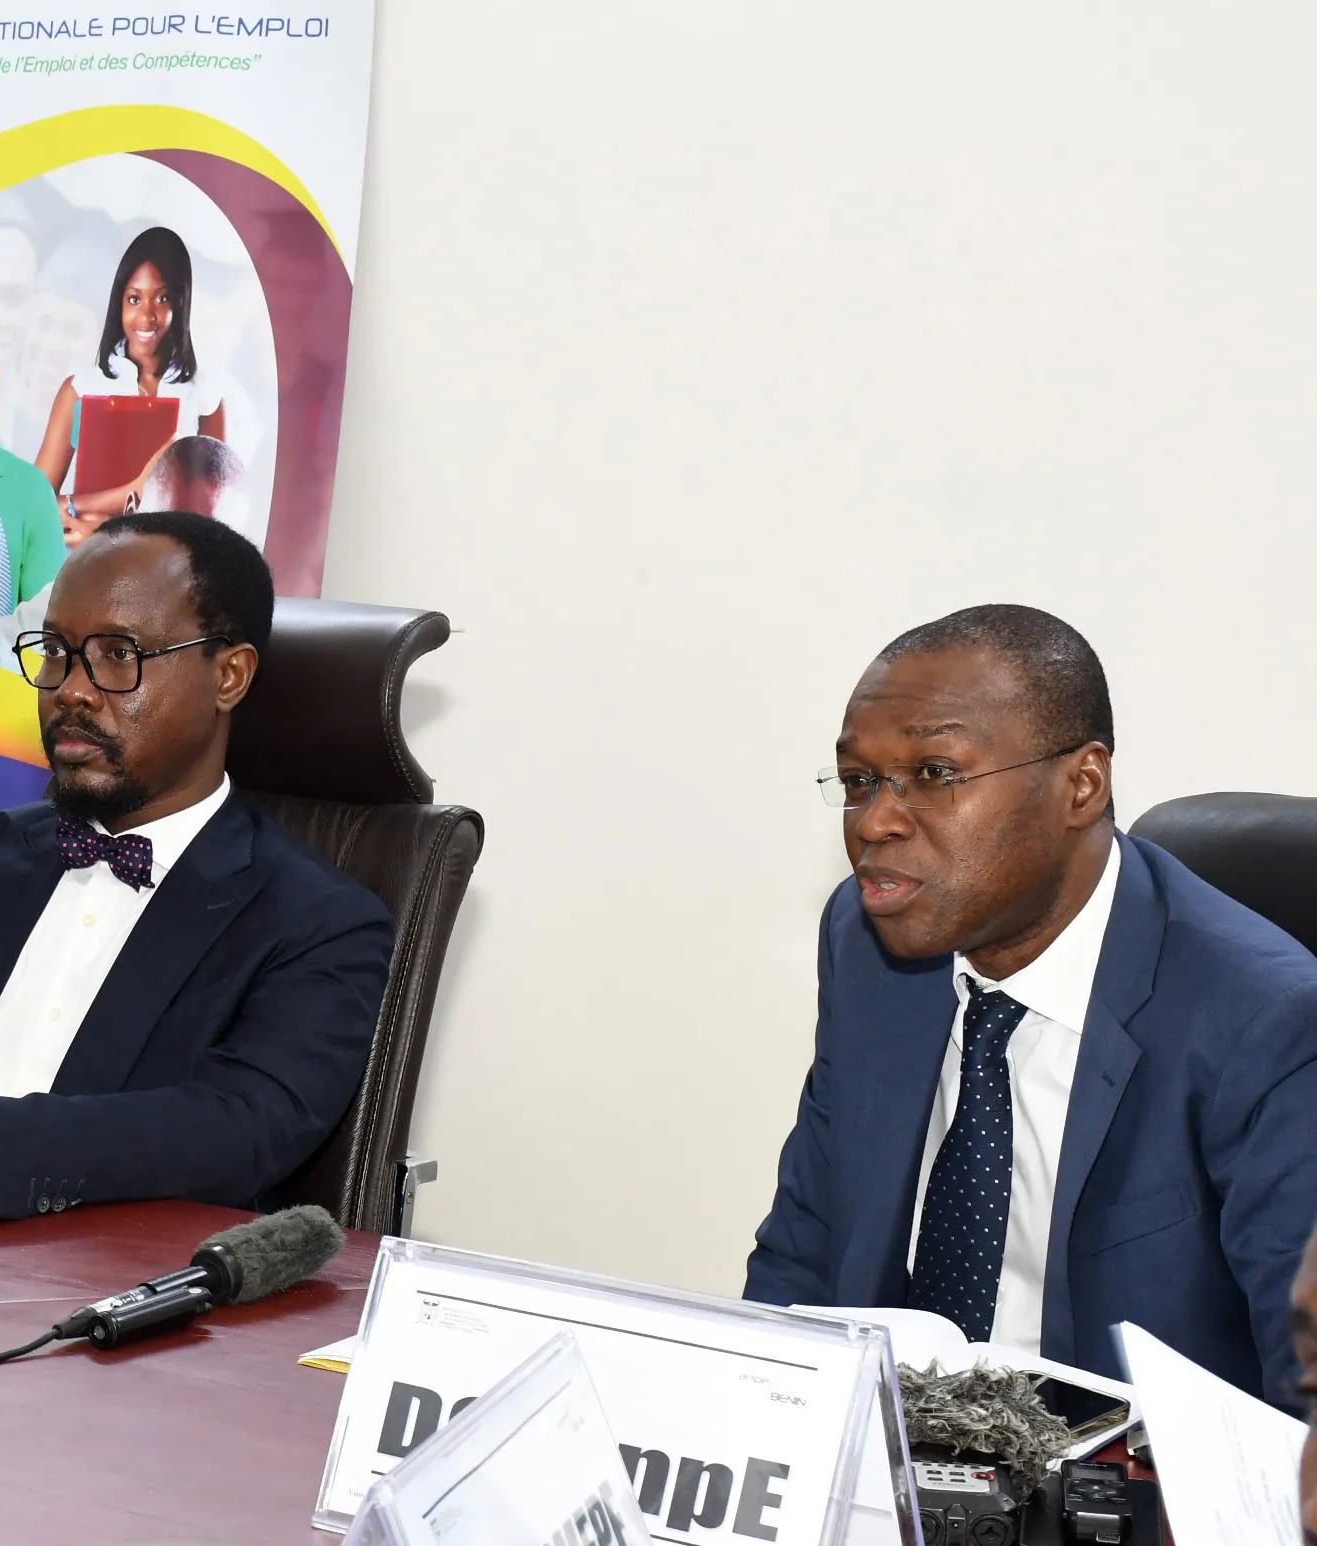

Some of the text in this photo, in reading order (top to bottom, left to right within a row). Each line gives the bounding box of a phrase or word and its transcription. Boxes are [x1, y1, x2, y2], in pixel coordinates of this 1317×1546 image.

[112, 14, 186, 36] POUR
[194, 14, 330, 38] L'EMPLOI
[14, 54, 78, 76] l'Emploi
[79, 54, 95, 71] et
[97, 53, 128, 70] des
